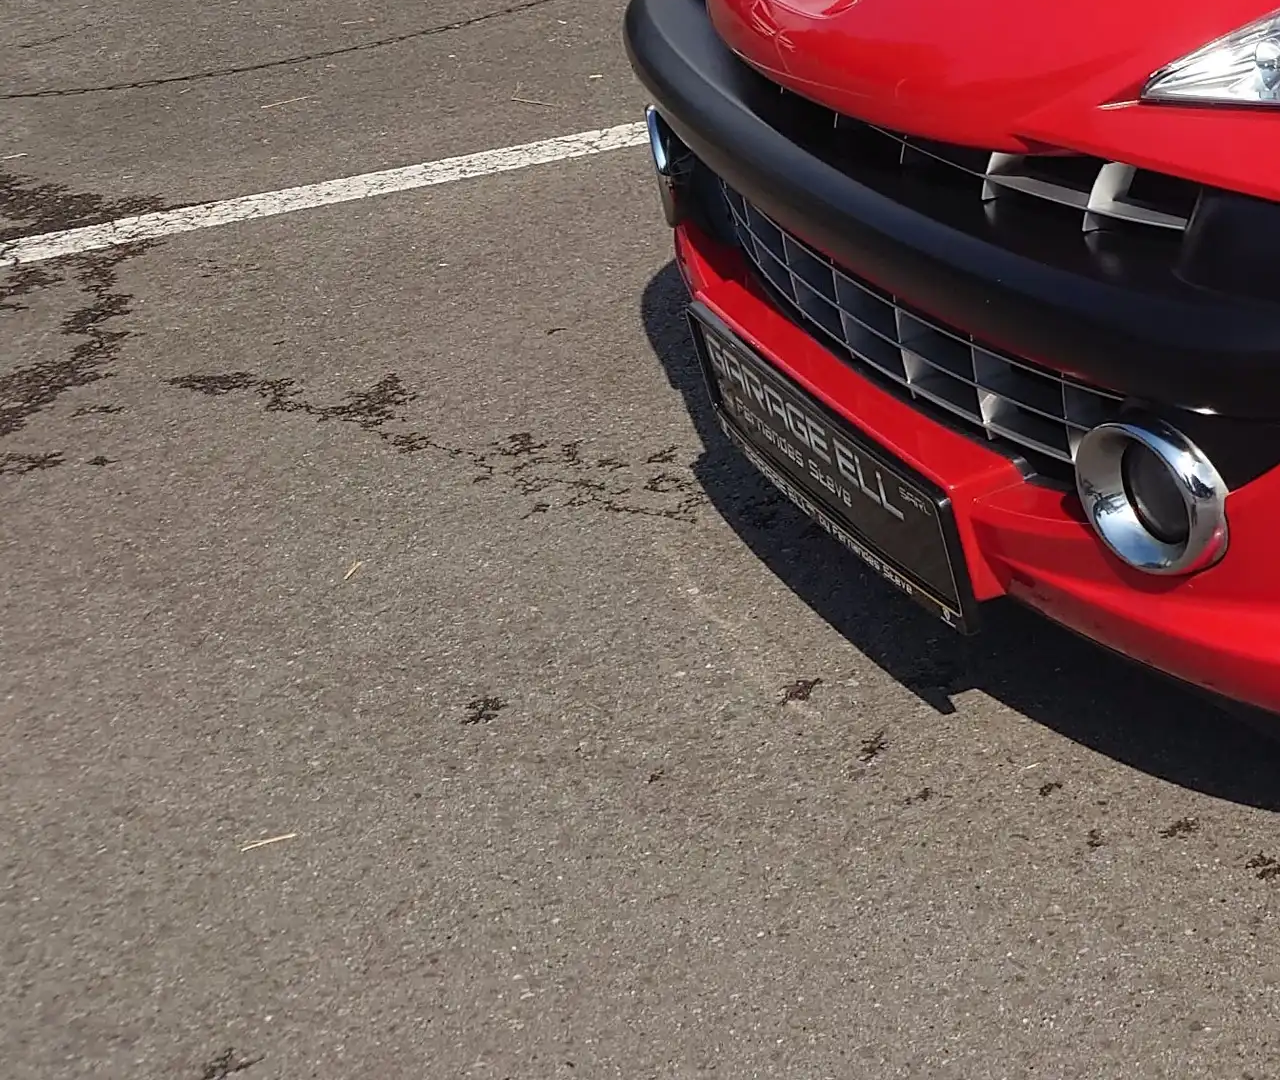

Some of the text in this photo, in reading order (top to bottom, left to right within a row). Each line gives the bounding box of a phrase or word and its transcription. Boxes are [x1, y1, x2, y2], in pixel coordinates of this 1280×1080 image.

[706, 334, 832, 466] GARAGE
[832, 436, 905, 521] ELL
[735, 396, 853, 508] Fernandes Steve
[883, 563, 913, 596] Steve
